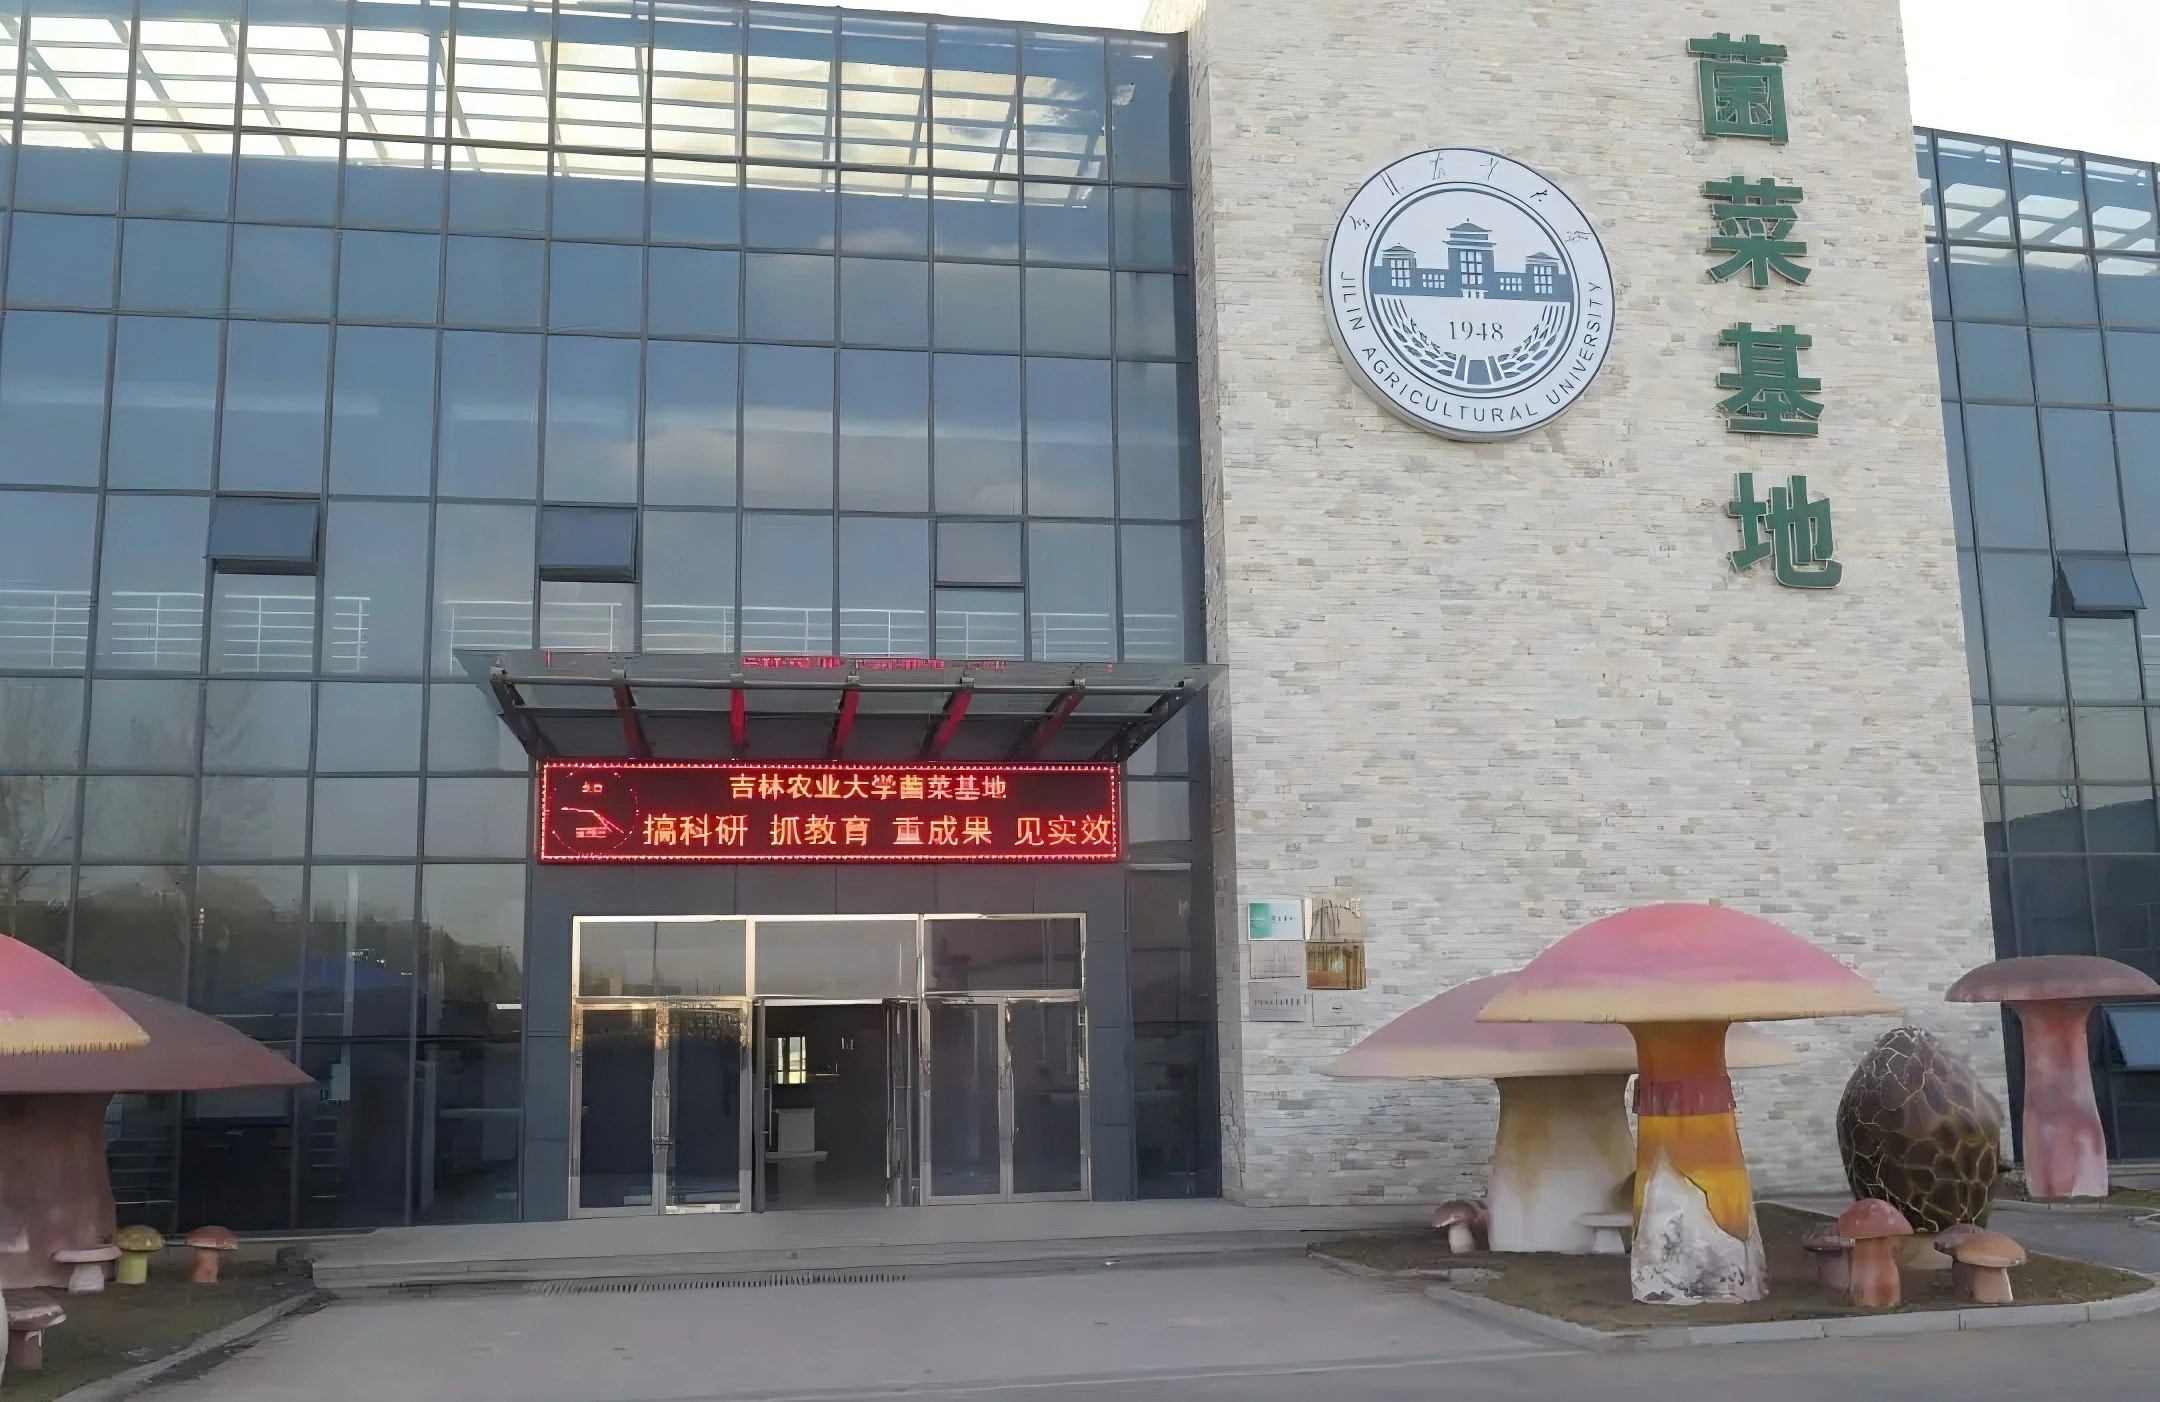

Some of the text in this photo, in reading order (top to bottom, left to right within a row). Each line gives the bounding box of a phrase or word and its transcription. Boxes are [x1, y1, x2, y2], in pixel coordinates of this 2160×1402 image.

[1340, 271, 1604, 423] JILIN AGRICULTURAL UNIVERSITY
[1449, 321, 1505, 342] 1948
[1686, 31, 1843, 588] 菌菜基地
[643, 813, 1112, 847] 搞科研 抓教育 重成果 见实效
